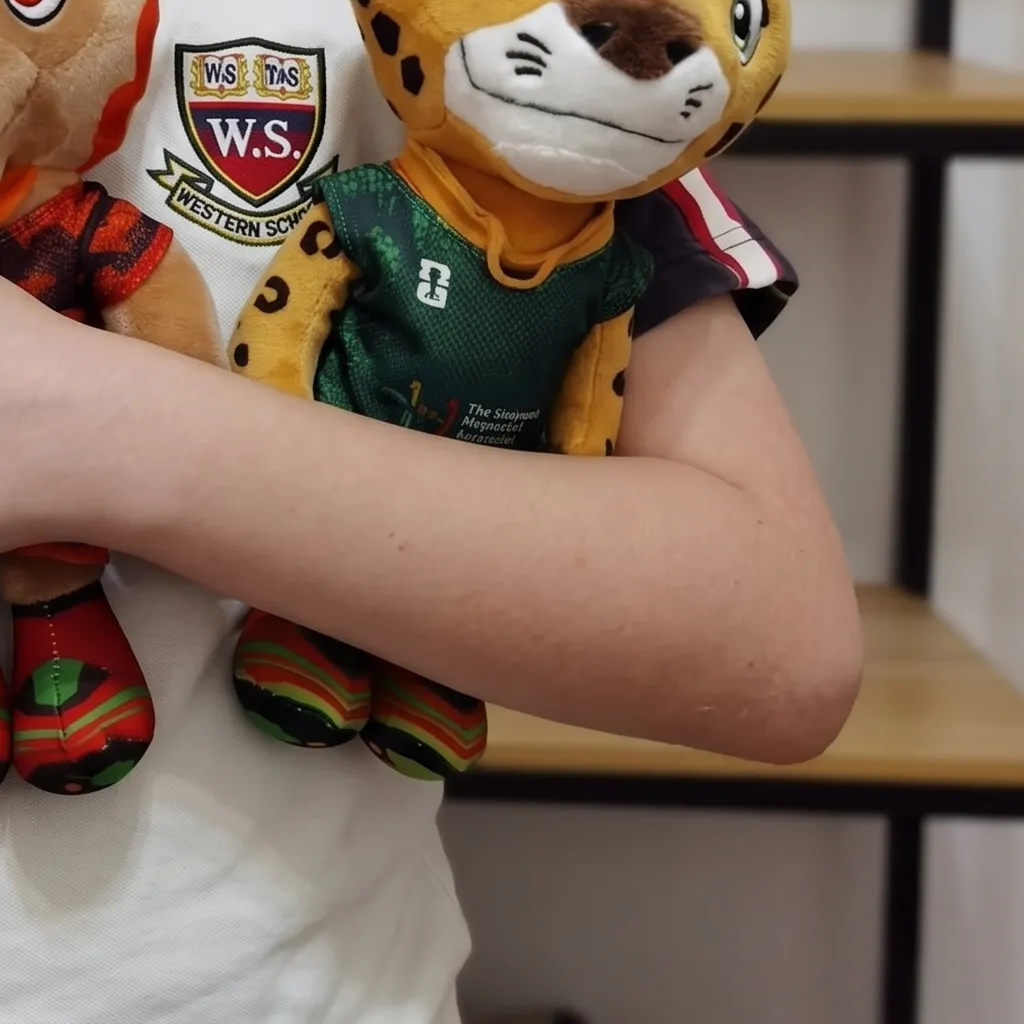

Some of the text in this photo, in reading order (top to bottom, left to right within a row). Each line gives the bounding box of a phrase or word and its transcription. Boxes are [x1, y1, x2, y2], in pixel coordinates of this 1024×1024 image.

[206, 118, 301, 159] W.S.
[177, 187, 261, 238] WESTERN
[469, 403, 492, 418] The
